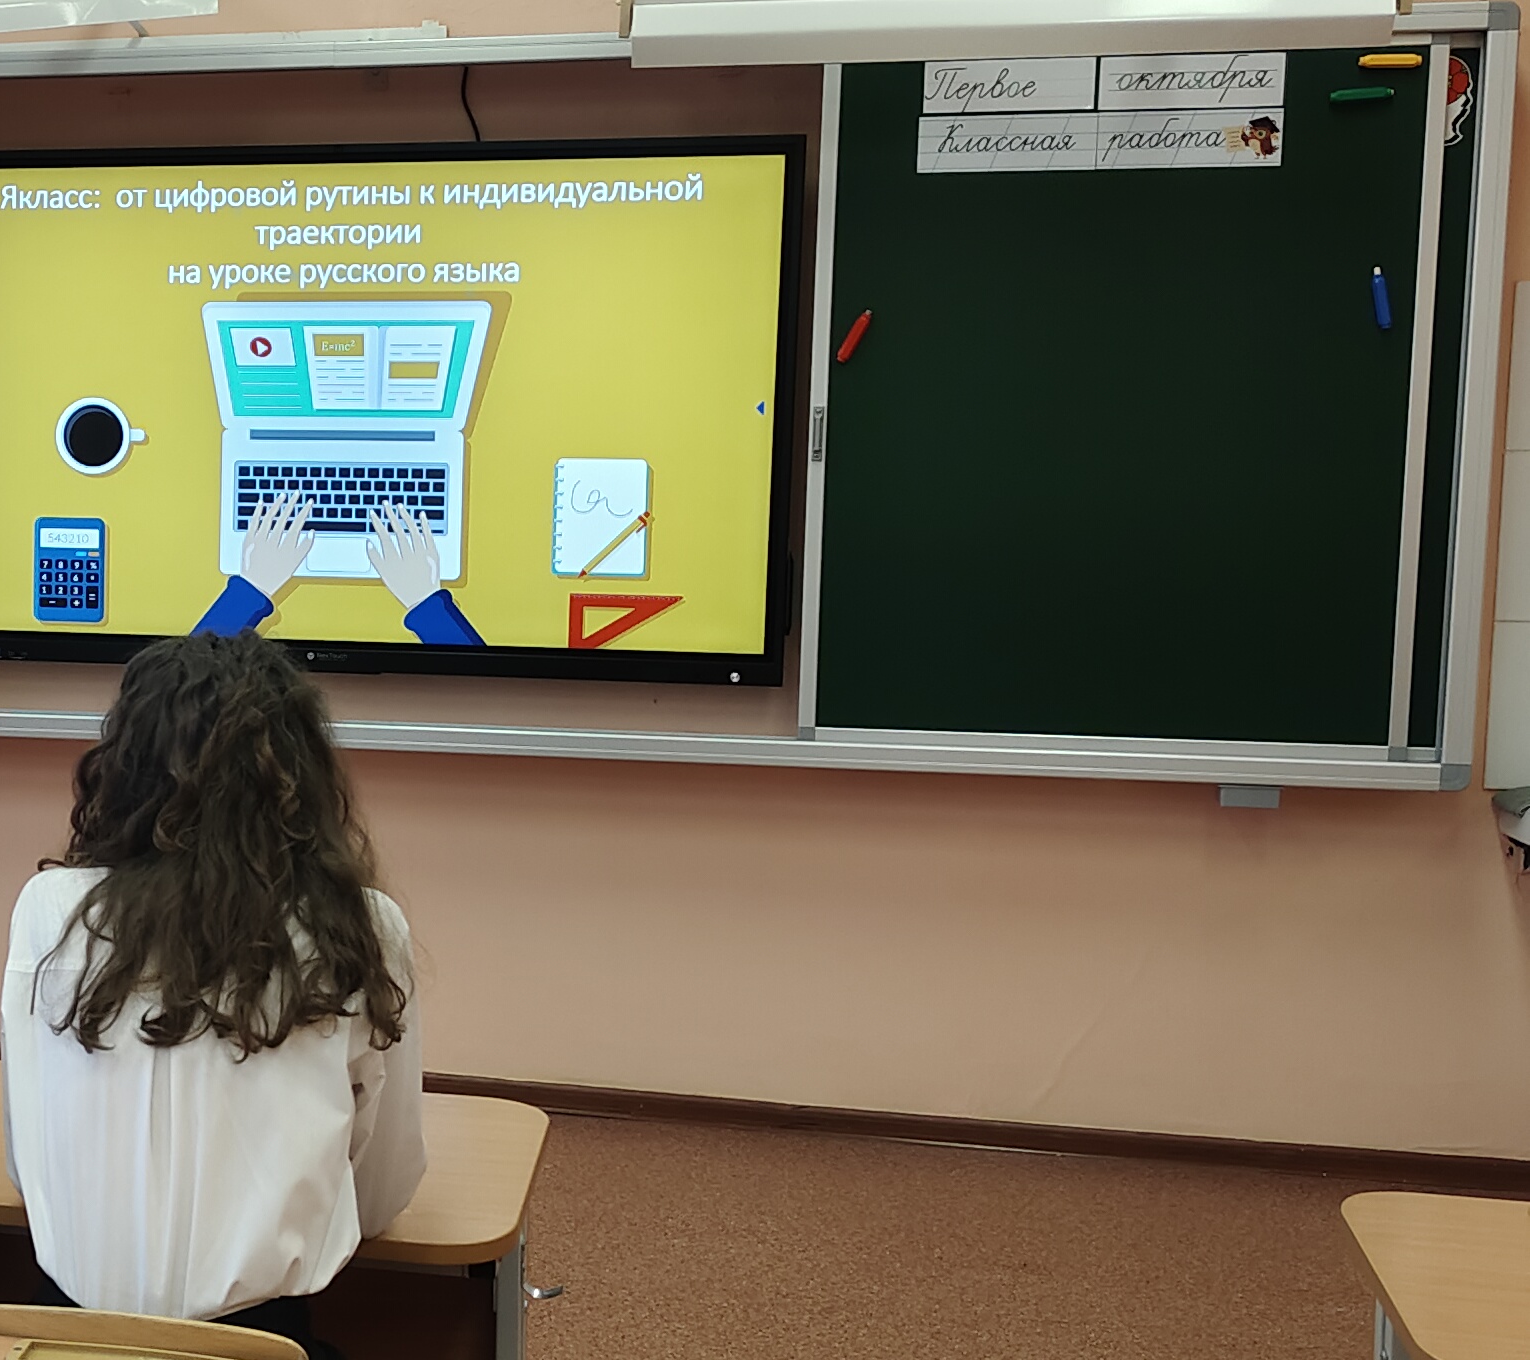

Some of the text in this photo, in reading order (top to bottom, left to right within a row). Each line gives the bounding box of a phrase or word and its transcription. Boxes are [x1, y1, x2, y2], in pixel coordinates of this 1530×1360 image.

[924, 54, 1273, 114] Первое октября
[937, 117, 1227, 163] Классная работа
[115, 189, 148, 209] от
[154, 179, 297, 214] цифровой
[305, 185, 411, 212] рутины
[419, 184, 435, 205] к
[443, 172, 703, 210] индивидуальной
[253, 223, 421, 251] траектории
[168, 261, 521, 290] на уроке русского языка
[47, 533, 89, 544] 543210
